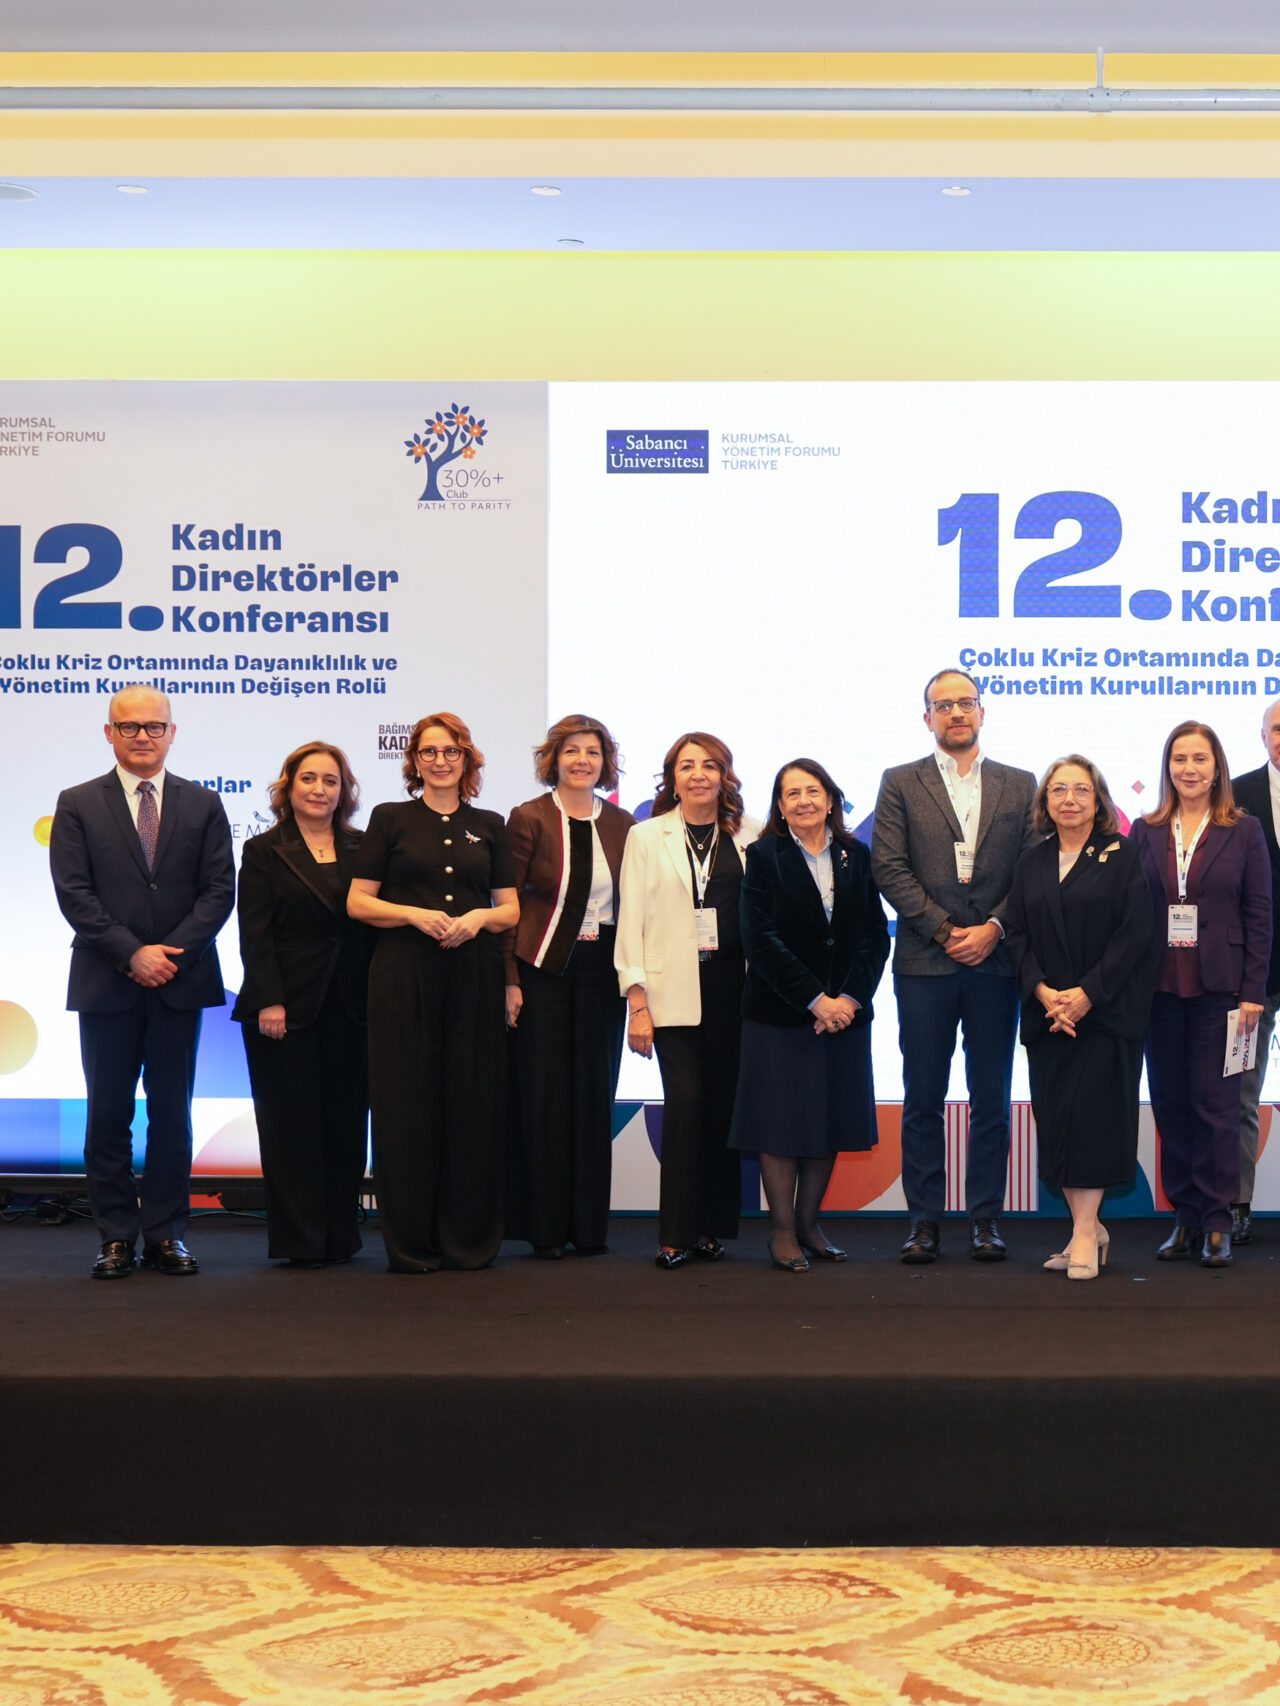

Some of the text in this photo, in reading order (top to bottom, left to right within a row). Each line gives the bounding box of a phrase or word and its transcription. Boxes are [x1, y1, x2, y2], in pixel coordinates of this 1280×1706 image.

[47, 432, 105, 442] FORUMU
[626, 434, 687, 449] Sabancı
[722, 433, 793, 443] KURUMSAL
[722, 445, 840, 456] YÖNETİM FORUMU
[722, 458, 777, 470] TÜRKİYE
[442, 469, 504, 488] 30%+
[446, 490, 468, 499] Club
[172, 523, 281, 550] Kadın
[938, 491, 1173, 621] 12.
[172, 563, 398, 592] Direktörler
[172, 604, 388, 633] Konferansı
[0, 654, 397, 675] oklu Kriz Ortamında Dayanıklılık ve
[959, 648, 1034, 671] Çoklu
[1042, 647, 1097, 667] Kriz
[1104, 647, 1249, 667] Ortamında
[0, 677, 89, 694] Yönetim
[242, 676, 330, 697] Değişen
[337, 677, 386, 694] Rolü
[974, 675, 1082, 695] Yönetim
[1091, 676, 1256, 695] Kurullarının
[379, 736, 409, 750] KAD
